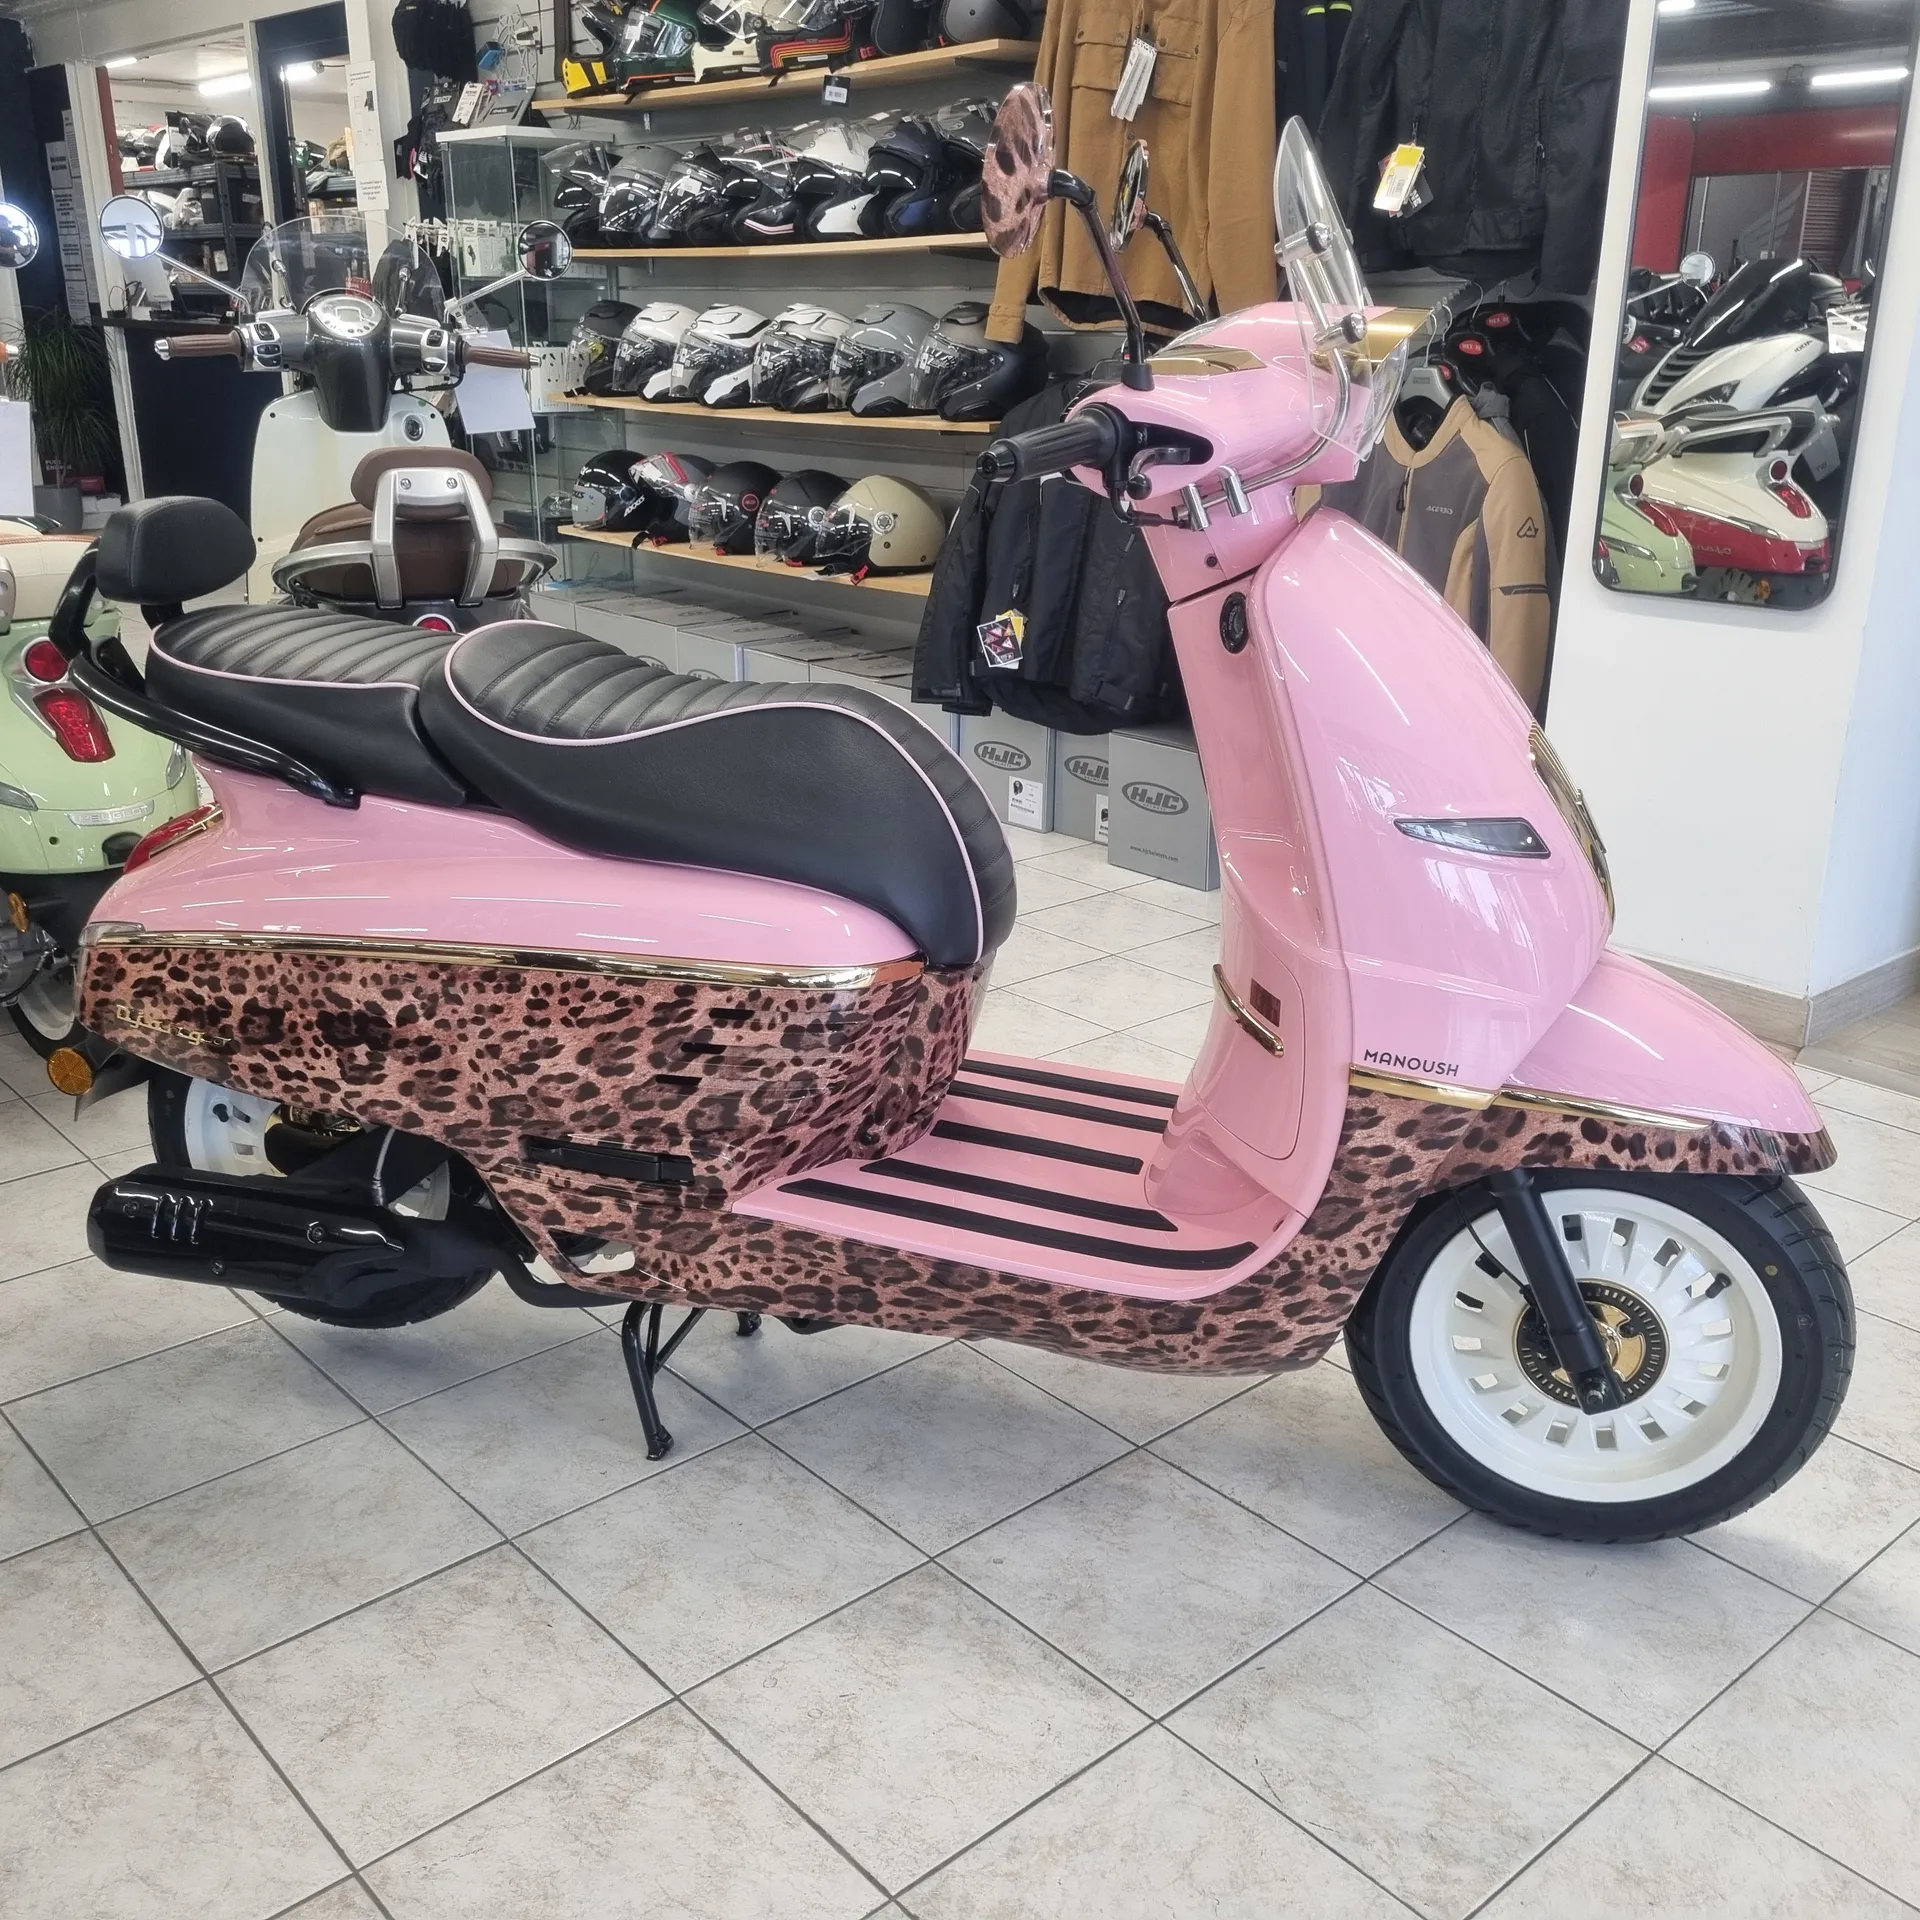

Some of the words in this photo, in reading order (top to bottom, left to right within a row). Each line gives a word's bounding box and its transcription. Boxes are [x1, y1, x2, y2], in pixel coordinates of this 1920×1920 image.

[981, 746, 1024, 767] HJC
[1130, 786, 1180, 811] HJC
[79, 805, 148, 823] PEUGEOT
[116, 1004, 232, 1046] Django
[1364, 1049, 1460, 1077] MANOUSH
